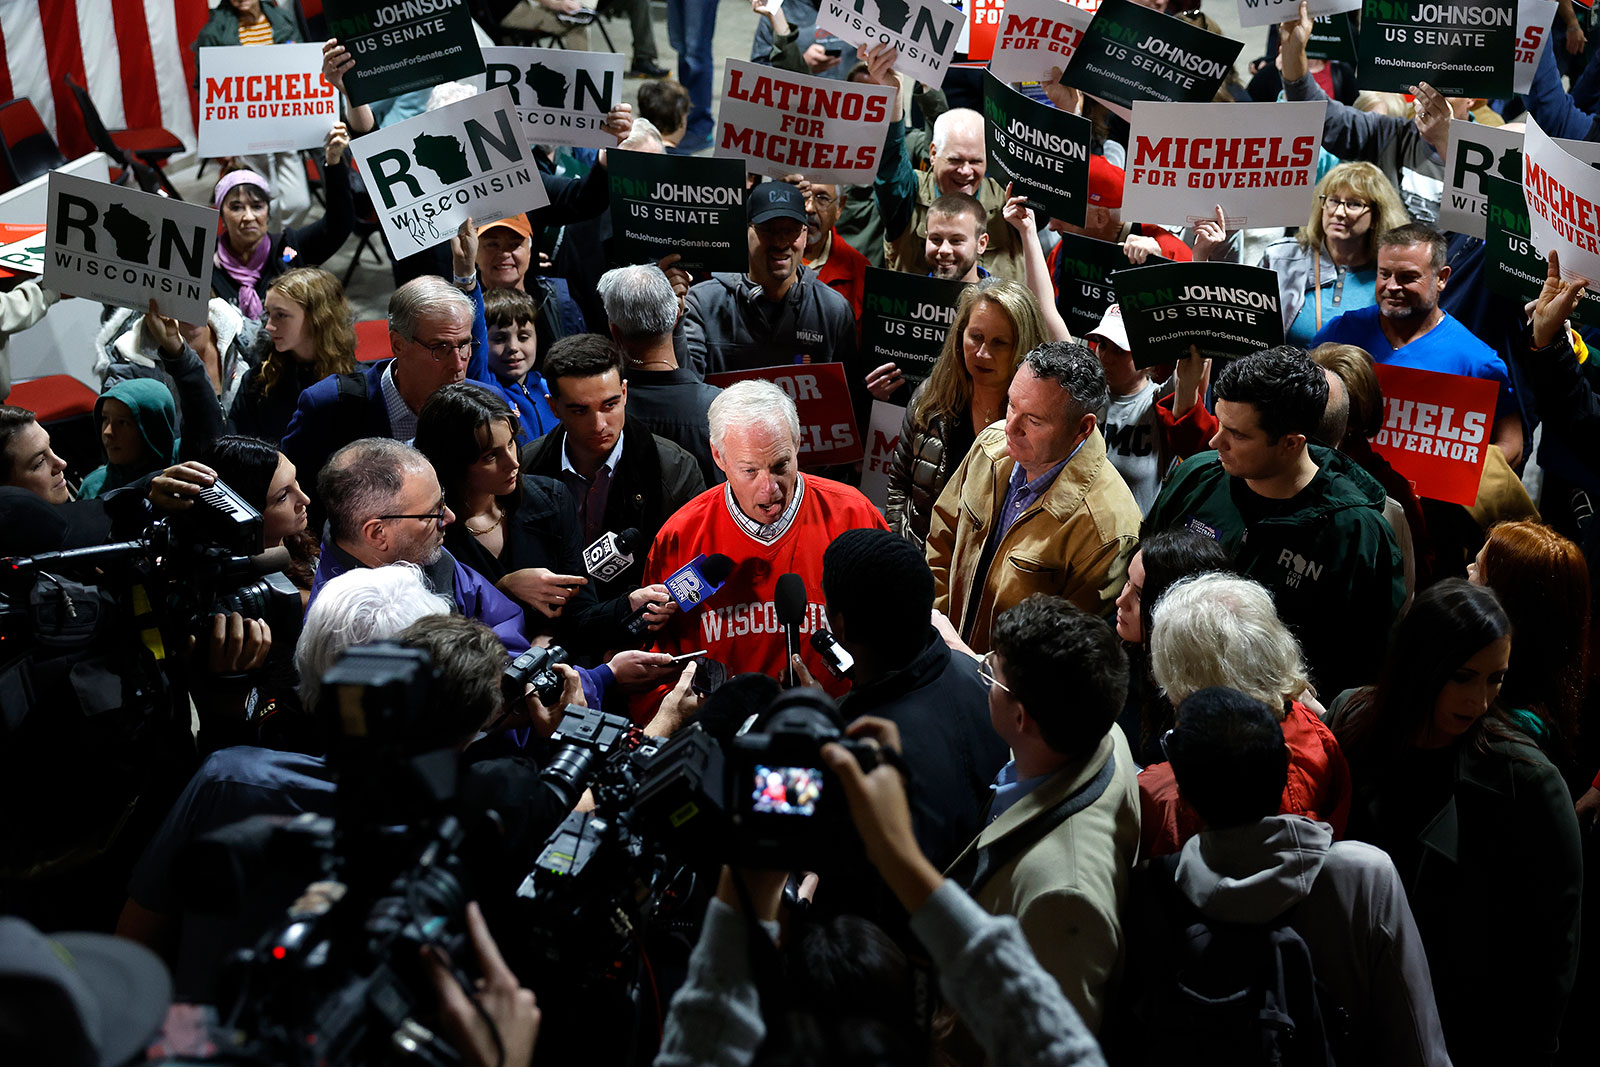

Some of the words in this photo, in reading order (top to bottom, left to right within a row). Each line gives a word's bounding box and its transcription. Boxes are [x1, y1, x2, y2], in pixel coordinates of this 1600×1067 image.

[373, 0, 463, 27] JOHNSON
[1411, 4, 1513, 27] JOHNSON
[355, 38, 378, 54] US
[381, 18, 446, 47] SENATE
[829, 3, 940, 70] WISCONSIN
[1001, 38, 1039, 49] FOR
[1385, 28, 1407, 42] US
[1414, 30, 1486, 48] SENATE
[356, 45, 462, 78] RonJohnsonForSenate.com
[1104, 44, 1128, 61] US
[1131, 55, 1195, 90] SENATE
[1137, 36, 1227, 80] JOHNSON
[1374, 57, 1495, 73] RonJohnsonForSenate.com
[206, 73, 334, 104] MICHELS
[728, 69, 888, 123] LATINOS
[205, 106, 239, 120] FOR
[247, 100, 335, 118] GOVERNOR
[780, 114, 825, 139] FOR
[721, 122, 877, 170] MICHELS
[994, 128, 1006, 148] US
[1008, 141, 1065, 174] SENATE
[1007, 118, 1087, 162] JOHNSON
[1133, 136, 1315, 170] MICHELS
[366, 108, 523, 210] RON
[1132, 168, 1177, 187] FOR
[1187, 170, 1309, 189] GOVERNOR
[391, 168, 531, 230] WISCONSIN
[650, 182, 743, 206] JOHNSON
[1526, 188, 1549, 221] FOR
[630, 203, 649, 219] US
[654, 207, 720, 225] SENATE
[55, 192, 207, 279] RON
[625, 229, 731, 249] RonJohnsonForSenate.com
[1509, 237, 1529, 256] US
[55, 251, 200, 301] WISCONSIN
[1081, 284, 1101, 300] US
[1178, 285, 1277, 313] JOHNSON
[885, 321, 906, 336] US
[1153, 308, 1179, 322] US
[1186, 306, 1257, 325] SENATE
[1148, 328, 1269, 350] RonJohnsonForSenate.com
[1382, 396, 1487, 444] HELS
[591, 546, 603, 563] 6
[602, 564, 618, 575] 6
[1286, 576, 1300, 589] WI
[669, 580, 686, 601] WISN
